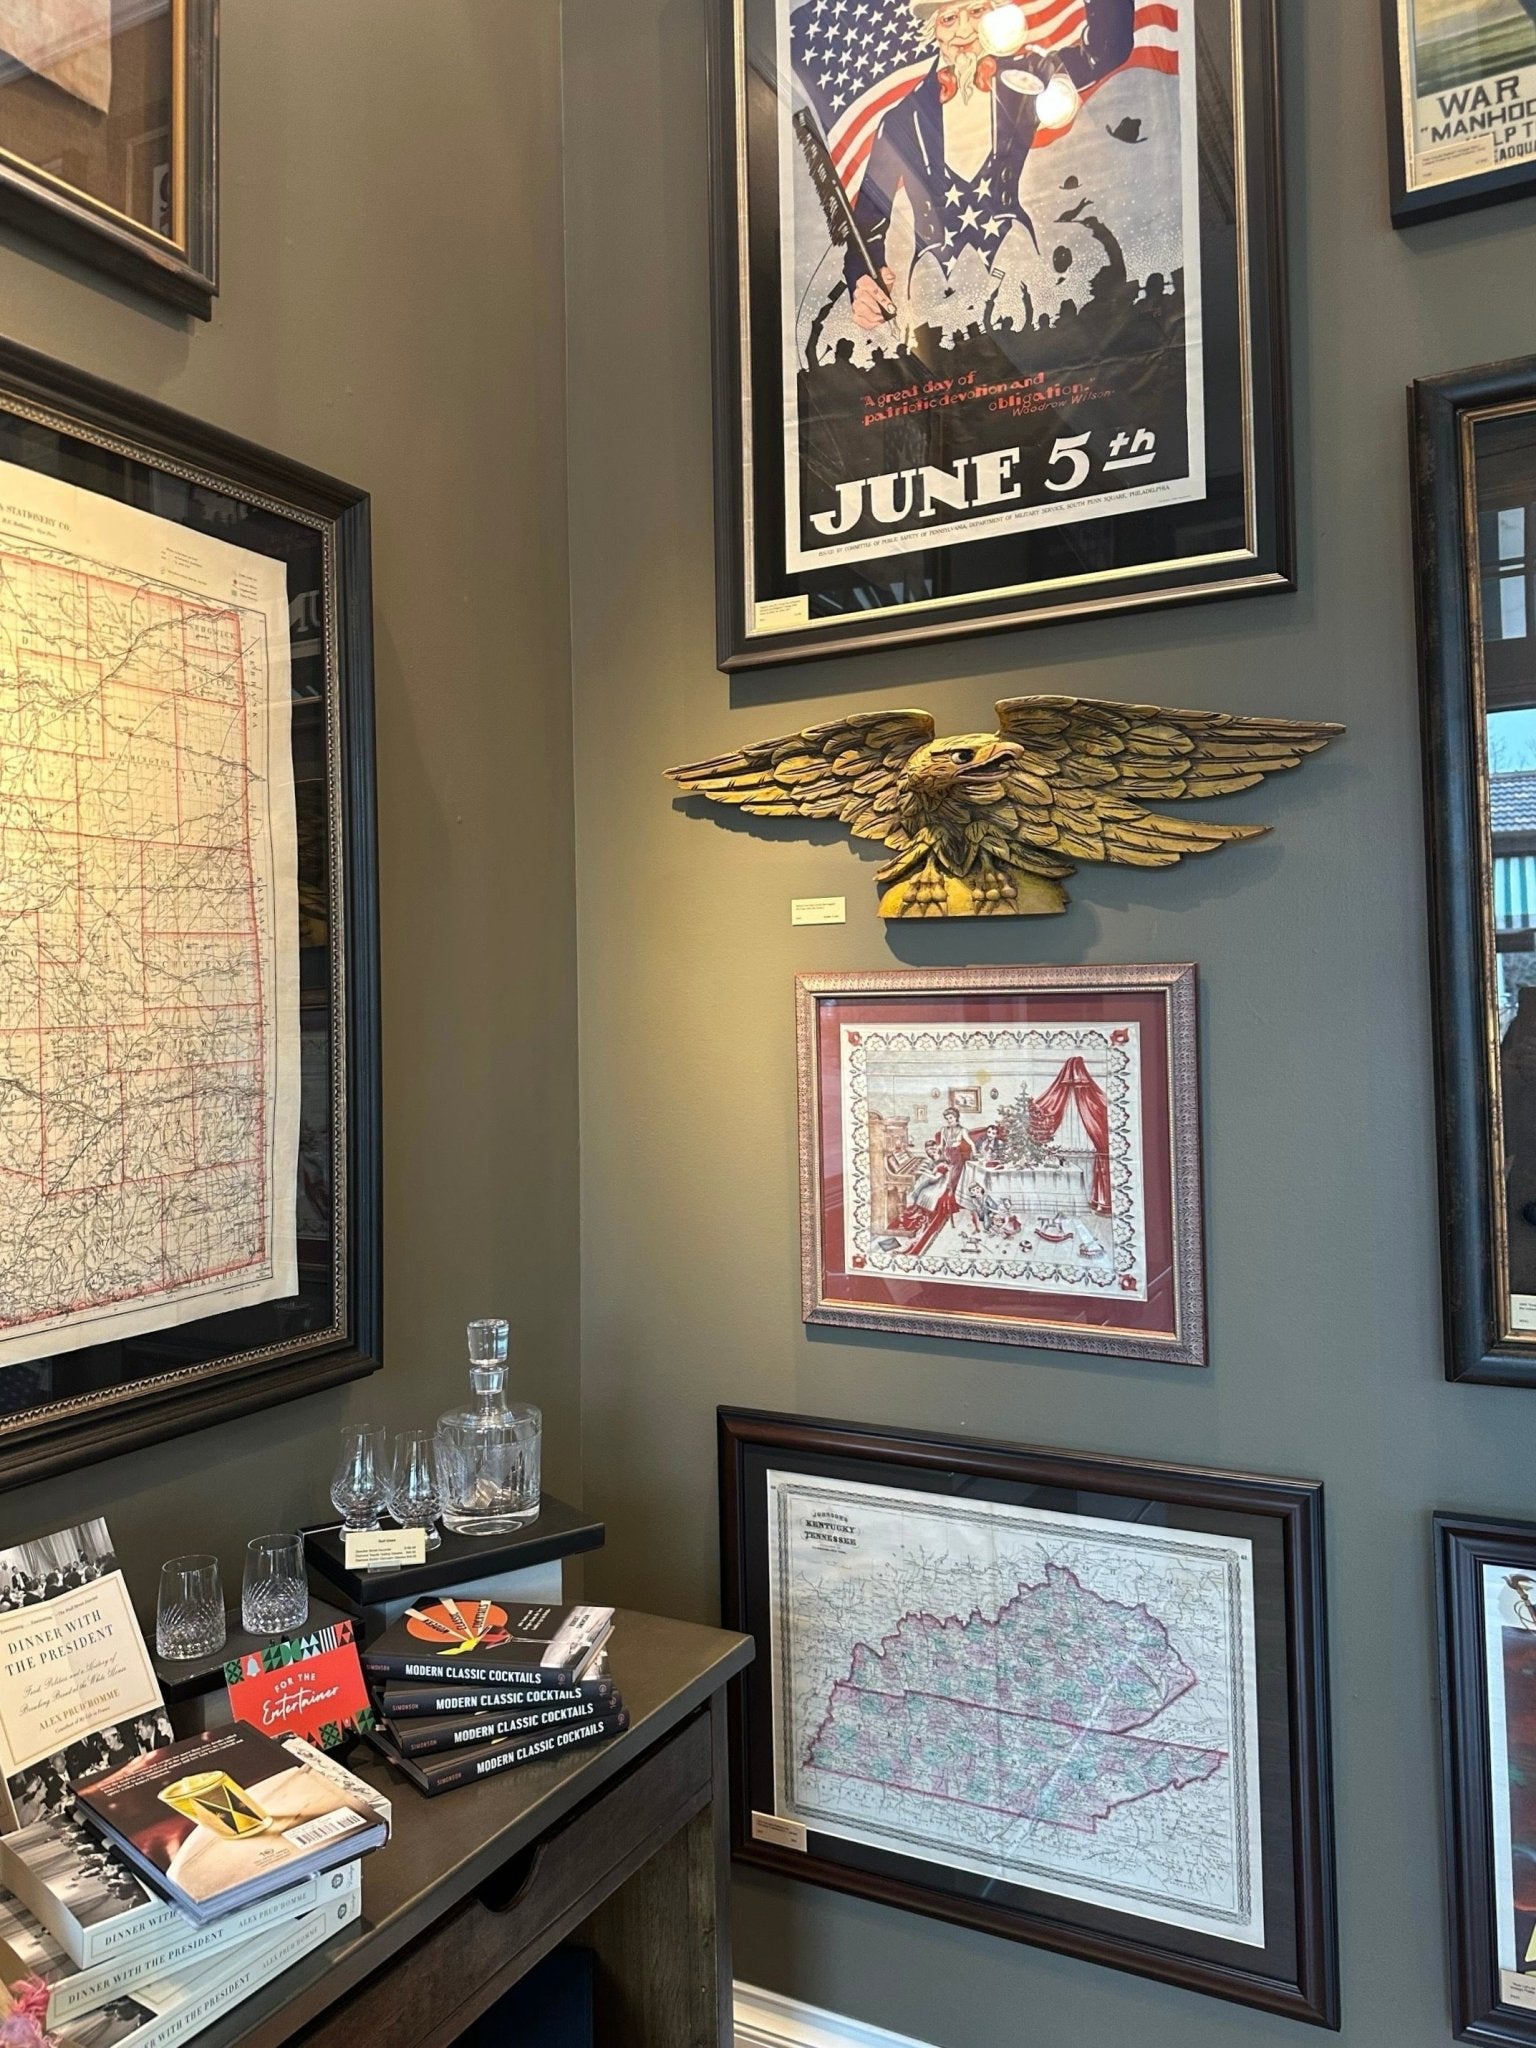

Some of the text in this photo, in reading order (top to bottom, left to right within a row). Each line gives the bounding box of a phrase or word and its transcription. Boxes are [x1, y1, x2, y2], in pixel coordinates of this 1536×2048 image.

[1438, 75, 1520, 119] WAR
[864, 372, 1045, 426] patriotic devotion and
[878, 385, 919, 407] great
[923, 378, 955, 395] day
[958, 370, 977, 386] of
[1012, 399, 1068, 417] Woodrow
[810, 427, 1157, 536] JUNE 5 th
[900, 533, 919, 542] SAFETY
[969, 517, 1003, 529] DEPARTMENT
[1014, 509, 1040, 520] MILITARY
[1066, 501, 1086, 511] SOUTH
[1087, 498, 1102, 507] PENN
[1129, 485, 1170, 498] PHILADELPHIA
[804, 1531, 857, 1546] TENNESSEE
[805, 1519, 856, 1534] KENTUCKY
[8, 1627, 63, 1655] DINNER
[65, 1609, 102, 1633] WITH
[473, 1603, 489, 1629] COCKTAILS
[5, 1657, 36, 1677] THE
[40, 1624, 114, 1664] PRESIDENT
[275, 1672, 316, 1694] FOR THE
[365, 1663, 542, 1685] SIMONSON MODERN CLASSIC COCKTAILS
[263, 1686, 339, 1725] Entertainer
[392, 1687, 582, 1711] SIMONSON MODERN CLASSIC COCKTAILS
[39, 1713, 63, 1731] ALEX
[410, 1702, 594, 1750] SIMONSON MODERN CLASSIC COCKTAILS
[436, 1721, 604, 1786] SIMONSON MODERN CLASSIC COCKTAILS
[105, 1921, 147, 1947] DINNER
[68, 1978, 110, 2004] DINNER
[113, 1964, 143, 1987] WITH
[144, 1955, 166, 1971] THE
[168, 1928, 224, 1961] PRESIDENT
[238, 1913, 258, 1928] ALEX
[158, 2019, 183, 2040] WITH
[184, 2008, 203, 2024] THE
[204, 1973, 251, 2011] PRESIDENT
[261, 1955, 278, 1970] ALEX
